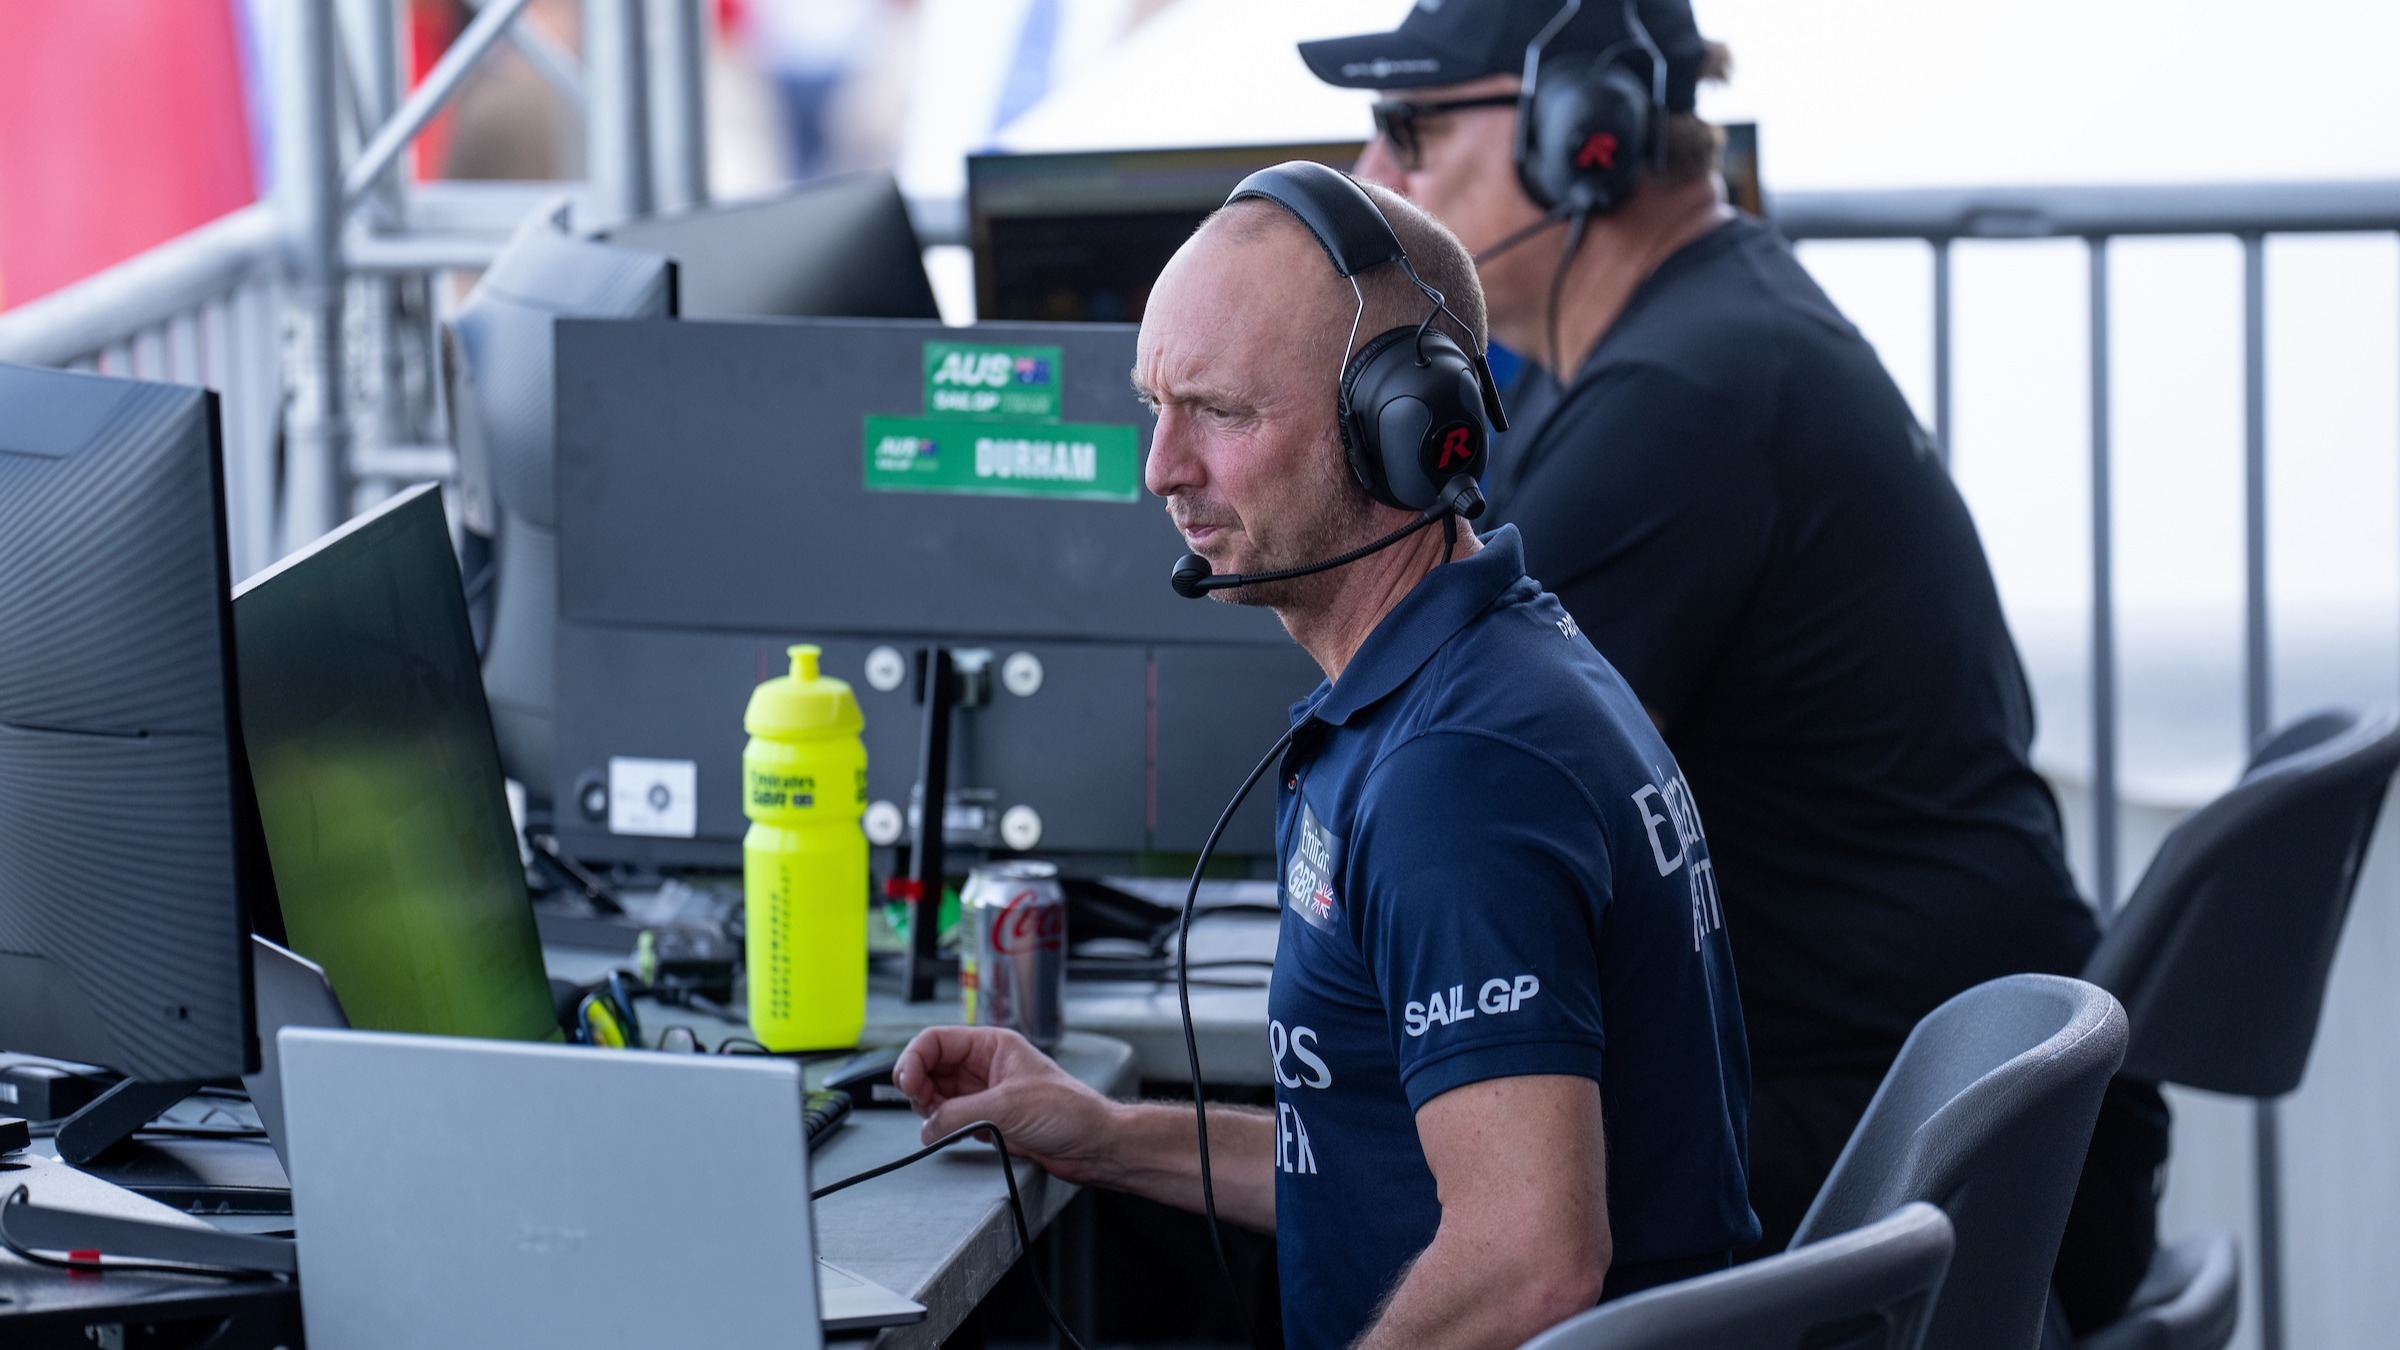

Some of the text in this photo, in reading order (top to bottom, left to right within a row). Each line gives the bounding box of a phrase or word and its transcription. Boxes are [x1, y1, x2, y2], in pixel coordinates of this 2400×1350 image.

[933, 352, 1012, 386] AUS
[975, 437, 1096, 481] DURHAM
[1438, 426, 1471, 470] R
[1288, 860, 1317, 907] GBR
[1405, 974, 1540, 1037] SAIL GP
